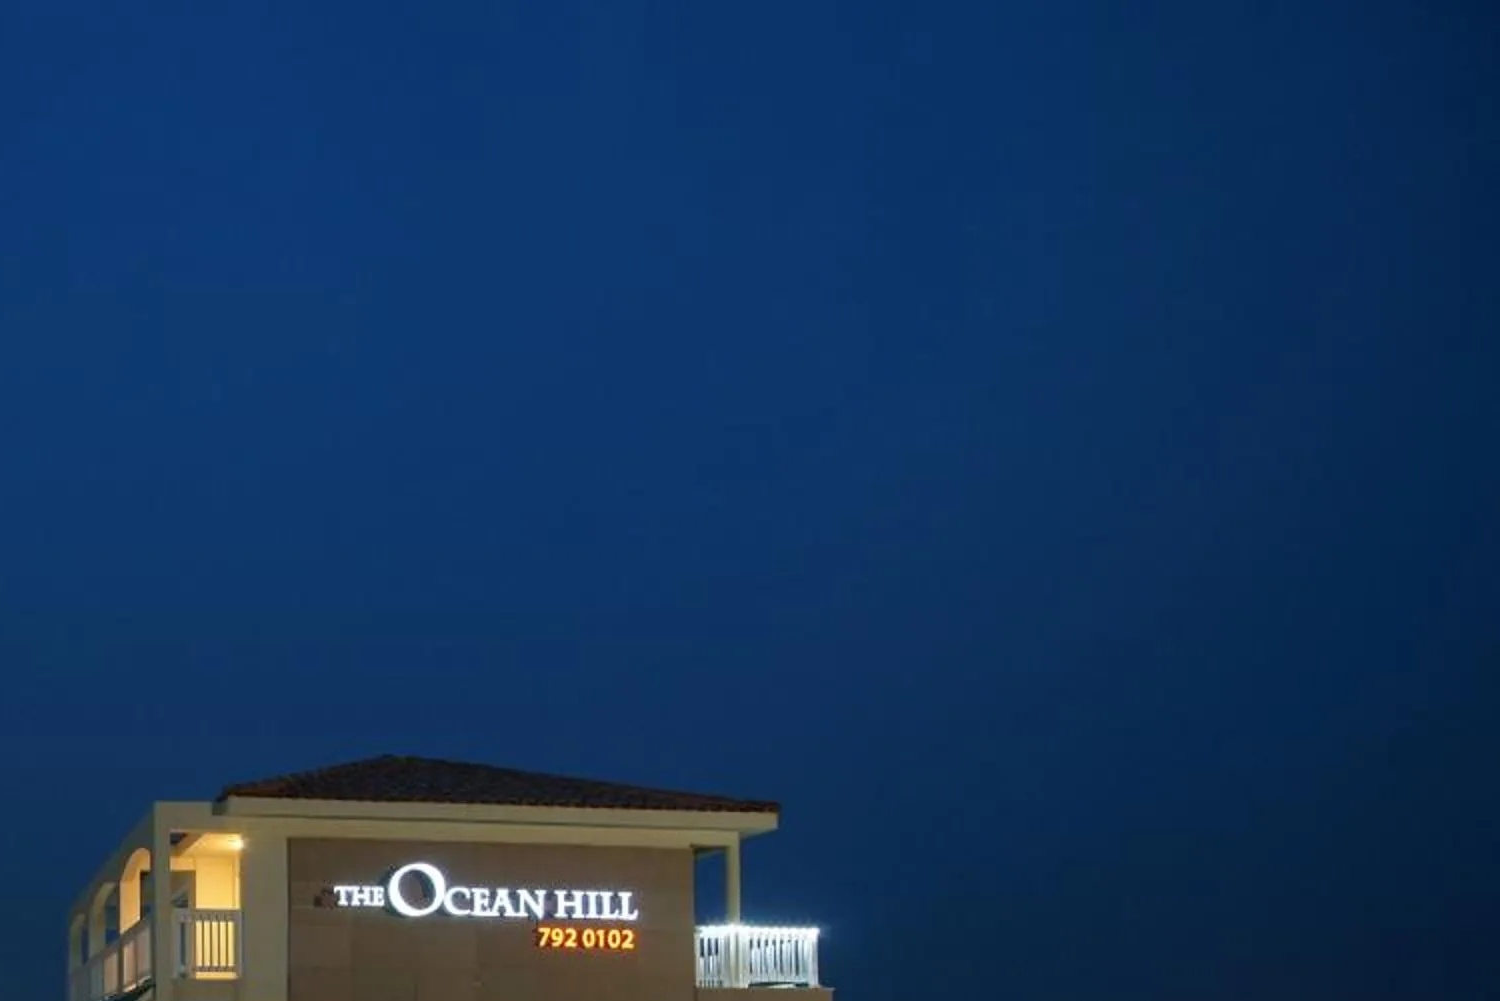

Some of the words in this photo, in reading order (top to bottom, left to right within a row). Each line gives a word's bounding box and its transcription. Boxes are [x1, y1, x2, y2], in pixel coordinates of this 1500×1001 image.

[333, 885, 385, 907] THE
[388, 862, 547, 920] OCEAN
[554, 889, 639, 921] HILL
[538, 927, 577, 948] 792
[581, 928, 635, 949] 0102
